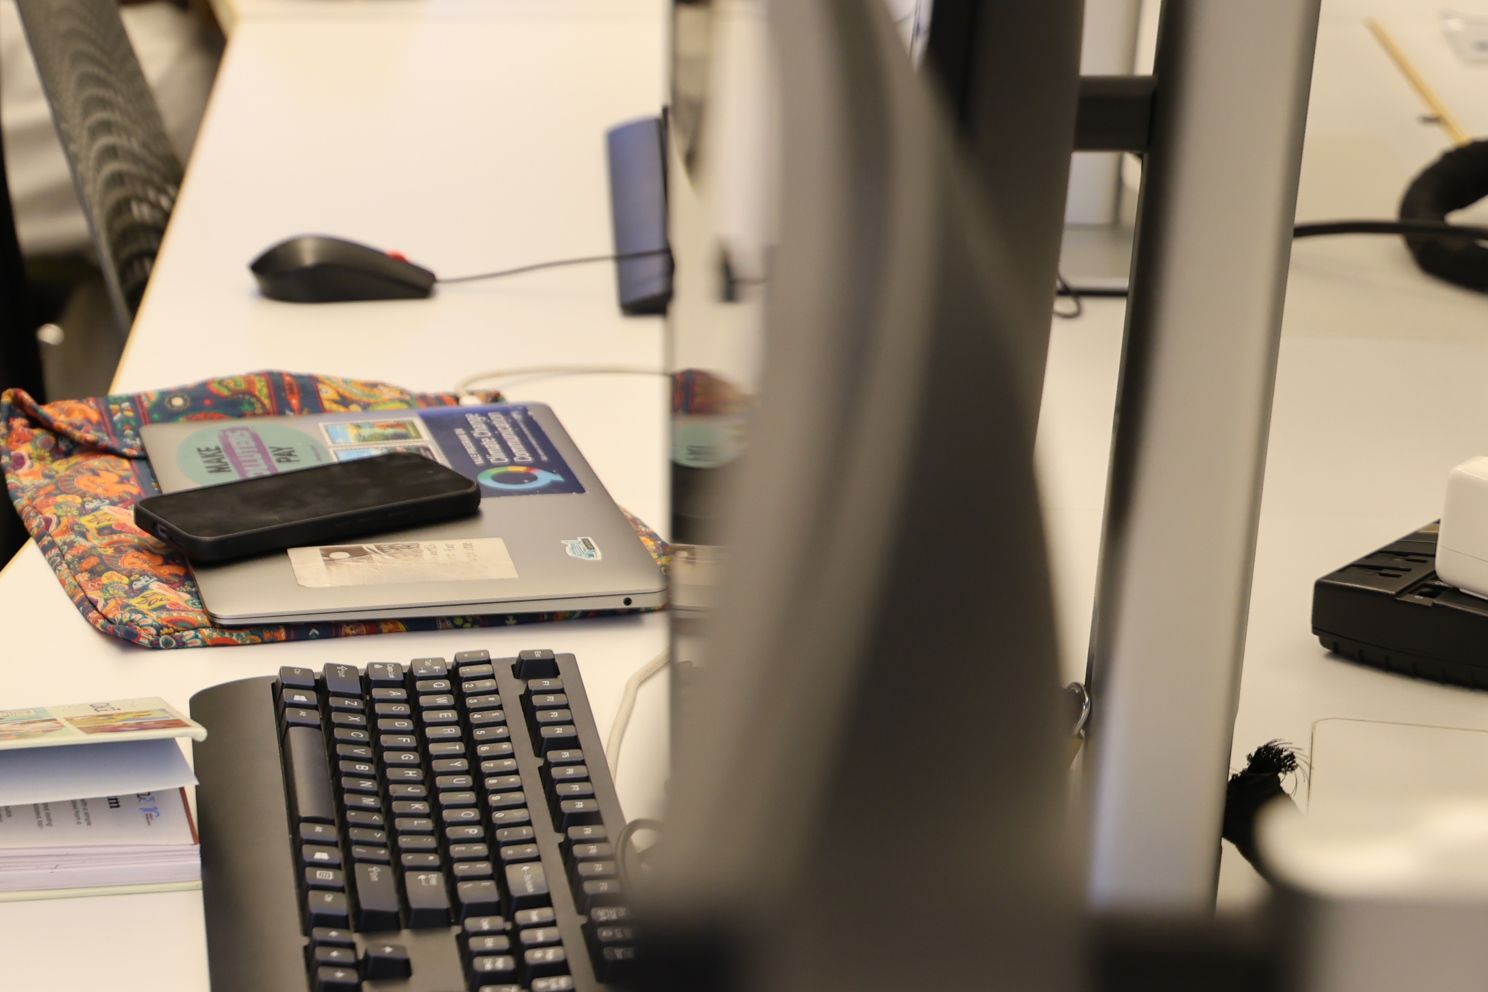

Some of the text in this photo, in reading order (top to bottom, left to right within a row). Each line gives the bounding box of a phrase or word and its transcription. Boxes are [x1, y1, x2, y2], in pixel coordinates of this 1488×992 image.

[269, 447, 300, 463] PAY
[465, 413, 509, 463] Climate Change
[488, 412, 533, 462] Communication
[196, 446, 232, 473] MAKE
